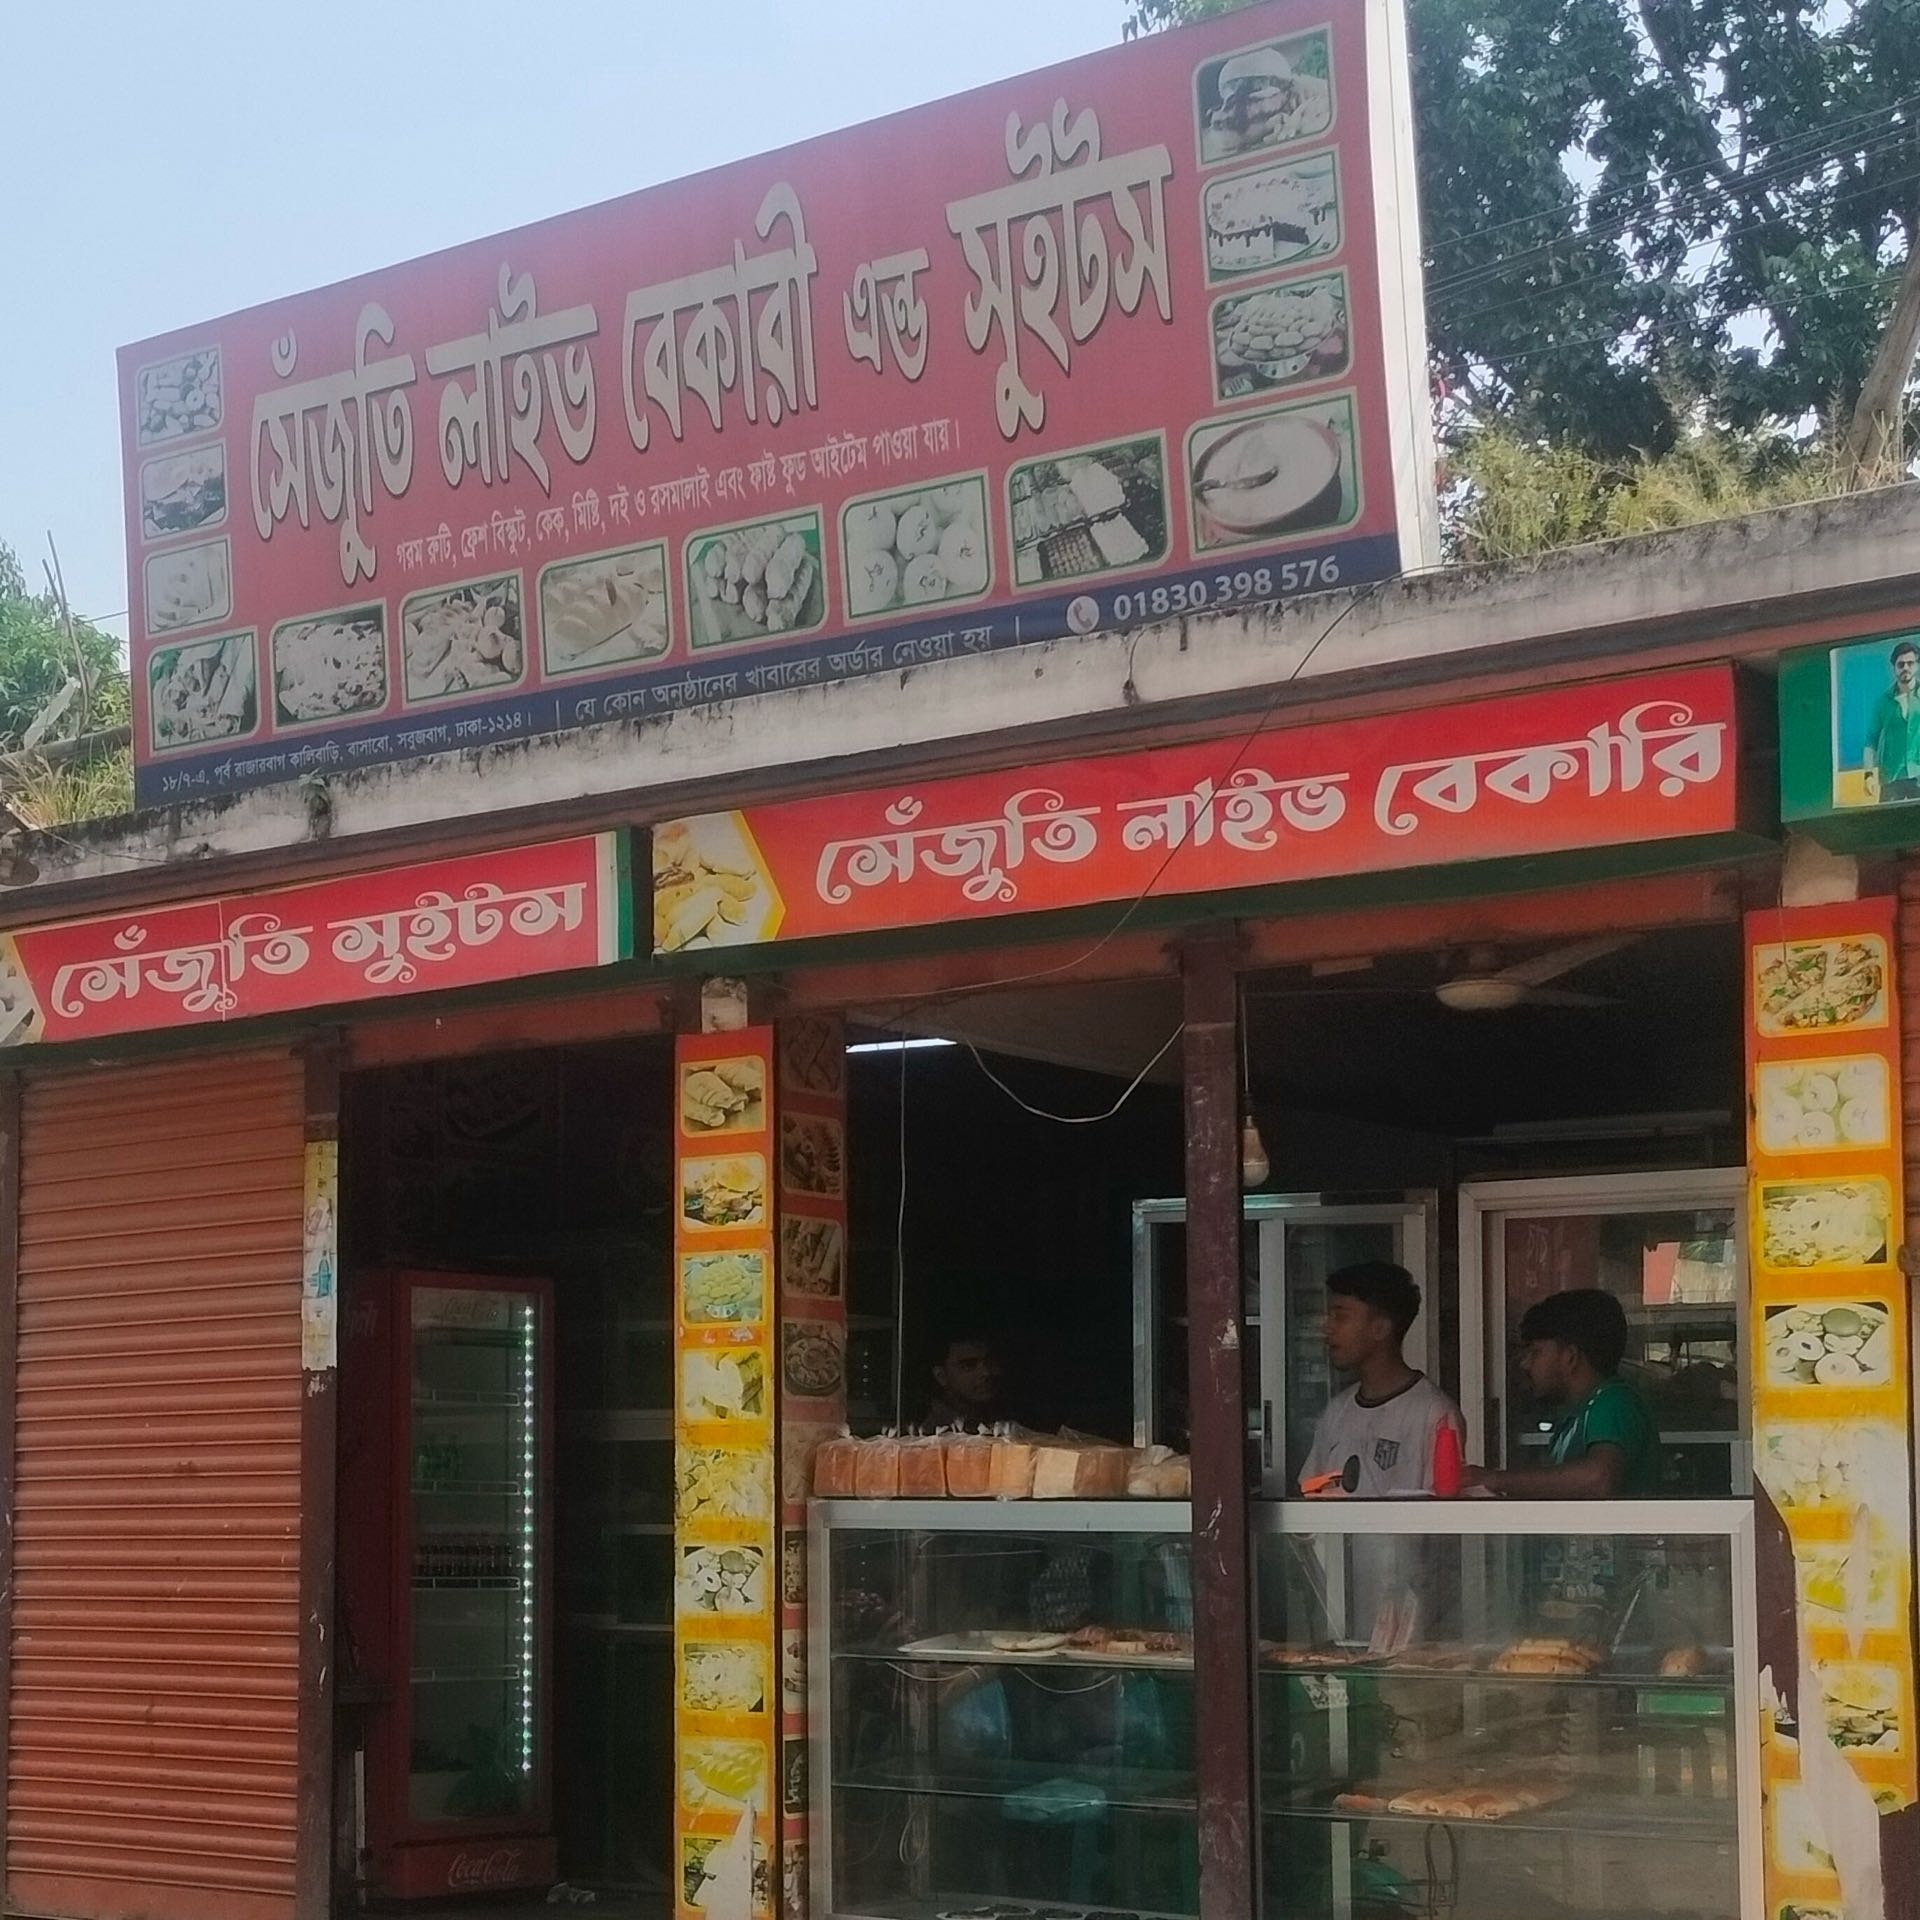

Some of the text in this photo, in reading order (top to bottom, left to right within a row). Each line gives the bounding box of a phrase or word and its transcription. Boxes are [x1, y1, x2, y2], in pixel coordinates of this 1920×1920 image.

[250, 98, 1174, 587] সেঁজুতি লাইভ বেকারী এন্ড সুইটস
[396, 539, 423, 571] গরম
[427, 522, 456, 567] রুটি,
[536, 507, 569, 543] কেক,
[572, 488, 605, 535] মিষ্টি,
[608, 483, 631, 525] দই
[636, 488, 646, 516] ও
[650, 464, 711, 515] রসমালাই
[715, 467, 746, 499] এবং
[780, 450, 806, 496] ফুড
[810, 430, 867, 477] আইটেম
[872, 424, 917, 466] পাওয়া
[1113, 555, 1340, 621] 01830 398 576
[575, 625, 993, 721] যে কোন অনুষ্ঠানের খাবারের অর্ডার নেওয়া হয়
[815, 702, 1727, 902] সেঁজুতি লাইভ বেকারি
[51, 882, 587, 1018] সেঁজুতি সুইটস
